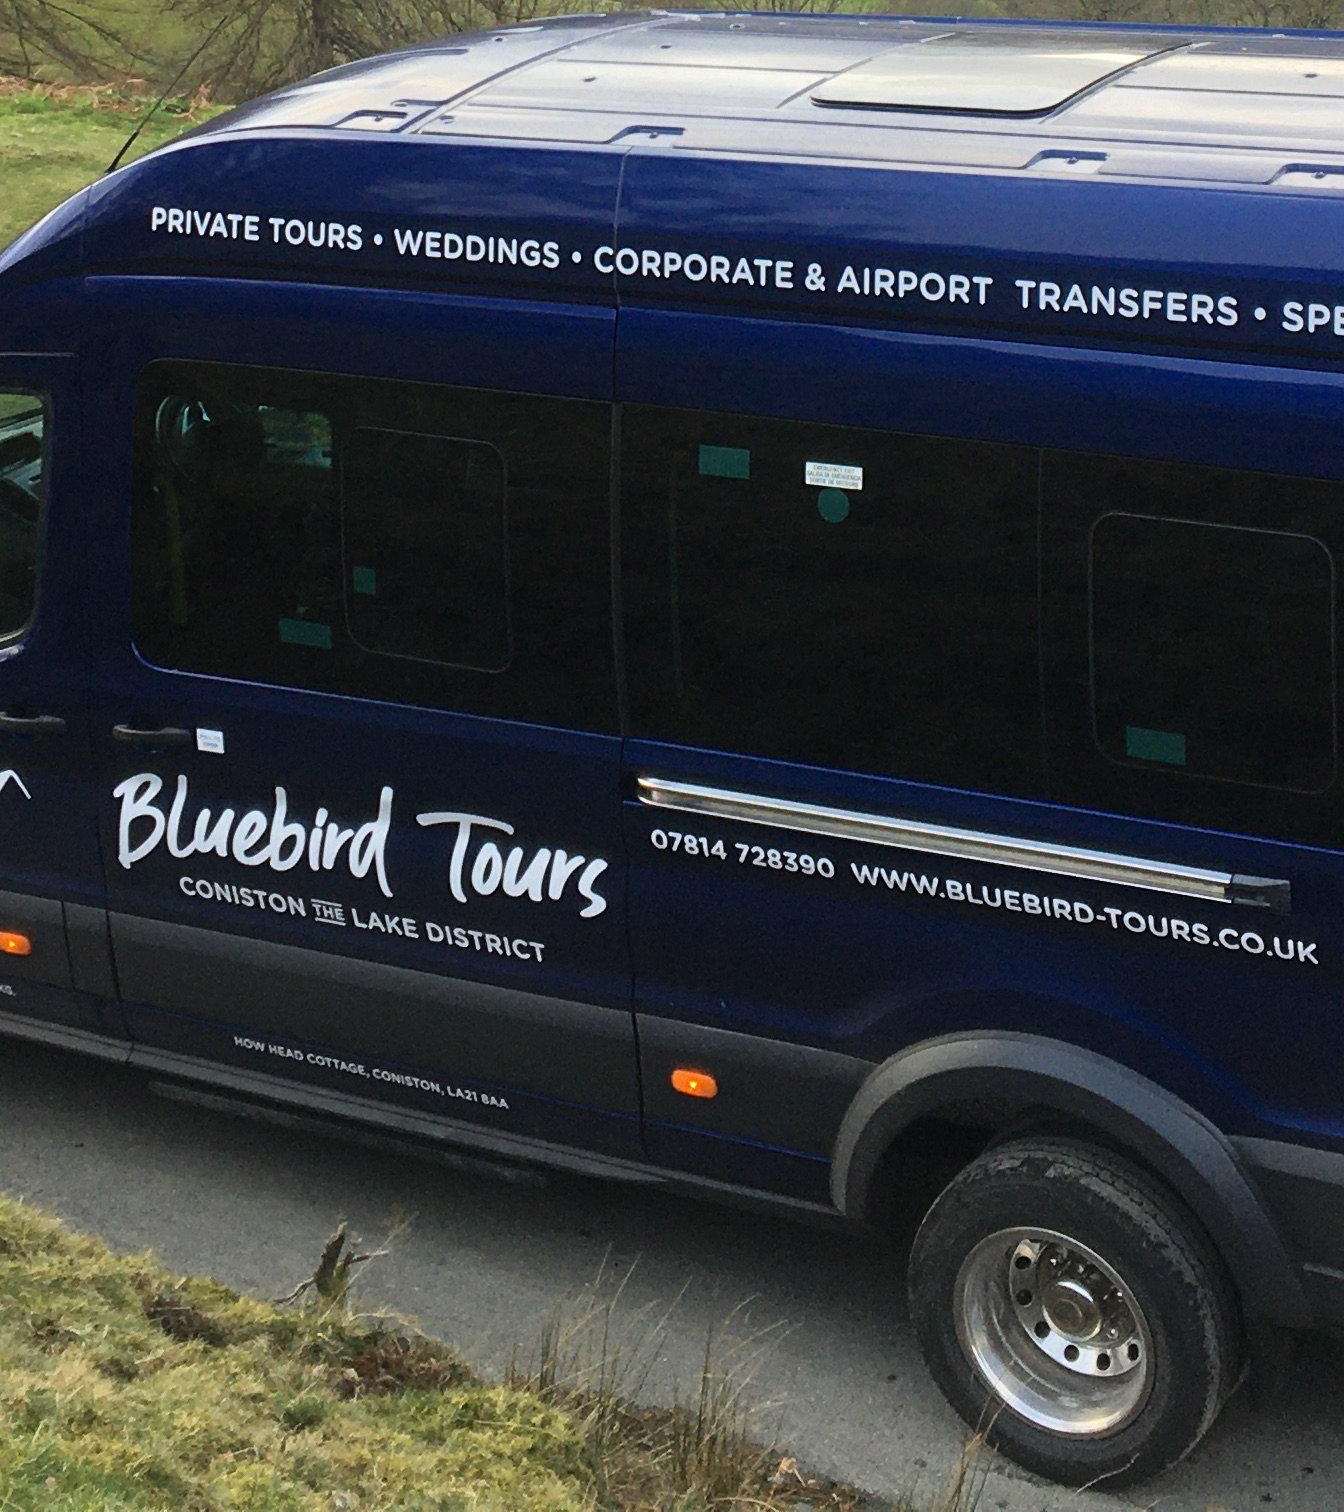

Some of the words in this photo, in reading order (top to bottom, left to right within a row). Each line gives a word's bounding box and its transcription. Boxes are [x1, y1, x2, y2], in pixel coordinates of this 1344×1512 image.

[151, 206, 260, 241] PRIVATE
[268, 217, 363, 251] TOURS
[393, 228, 560, 269] WEDDINGS
[594, 246, 794, 289] CORPORATE
[804, 262, 826, 292] &
[836, 265, 994, 306] AIRPORT
[1014, 279, 1238, 326] TRANSFERS
[112, 772, 394, 898] Bluebird
[415, 811, 609, 918] Tours
[650, 828, 728, 860] 07814
[734, 842, 835, 878] 728390
[850, 862, 1319, 965] WWW.BLUEBIRD-TOURS.CO.UK
[179, 876, 307, 917] CONISTON
[312, 900, 346, 925] THE
[351, 907, 420, 939] LAKE
[425, 921, 545, 963] DISTRICT
[233, 1036, 265, 1052] HOW
[268, 1044, 304, 1061] HEAD
[306, 1053, 371, 1079] COTTAGE,
[371, 1068, 445, 1096] CONISTON,
